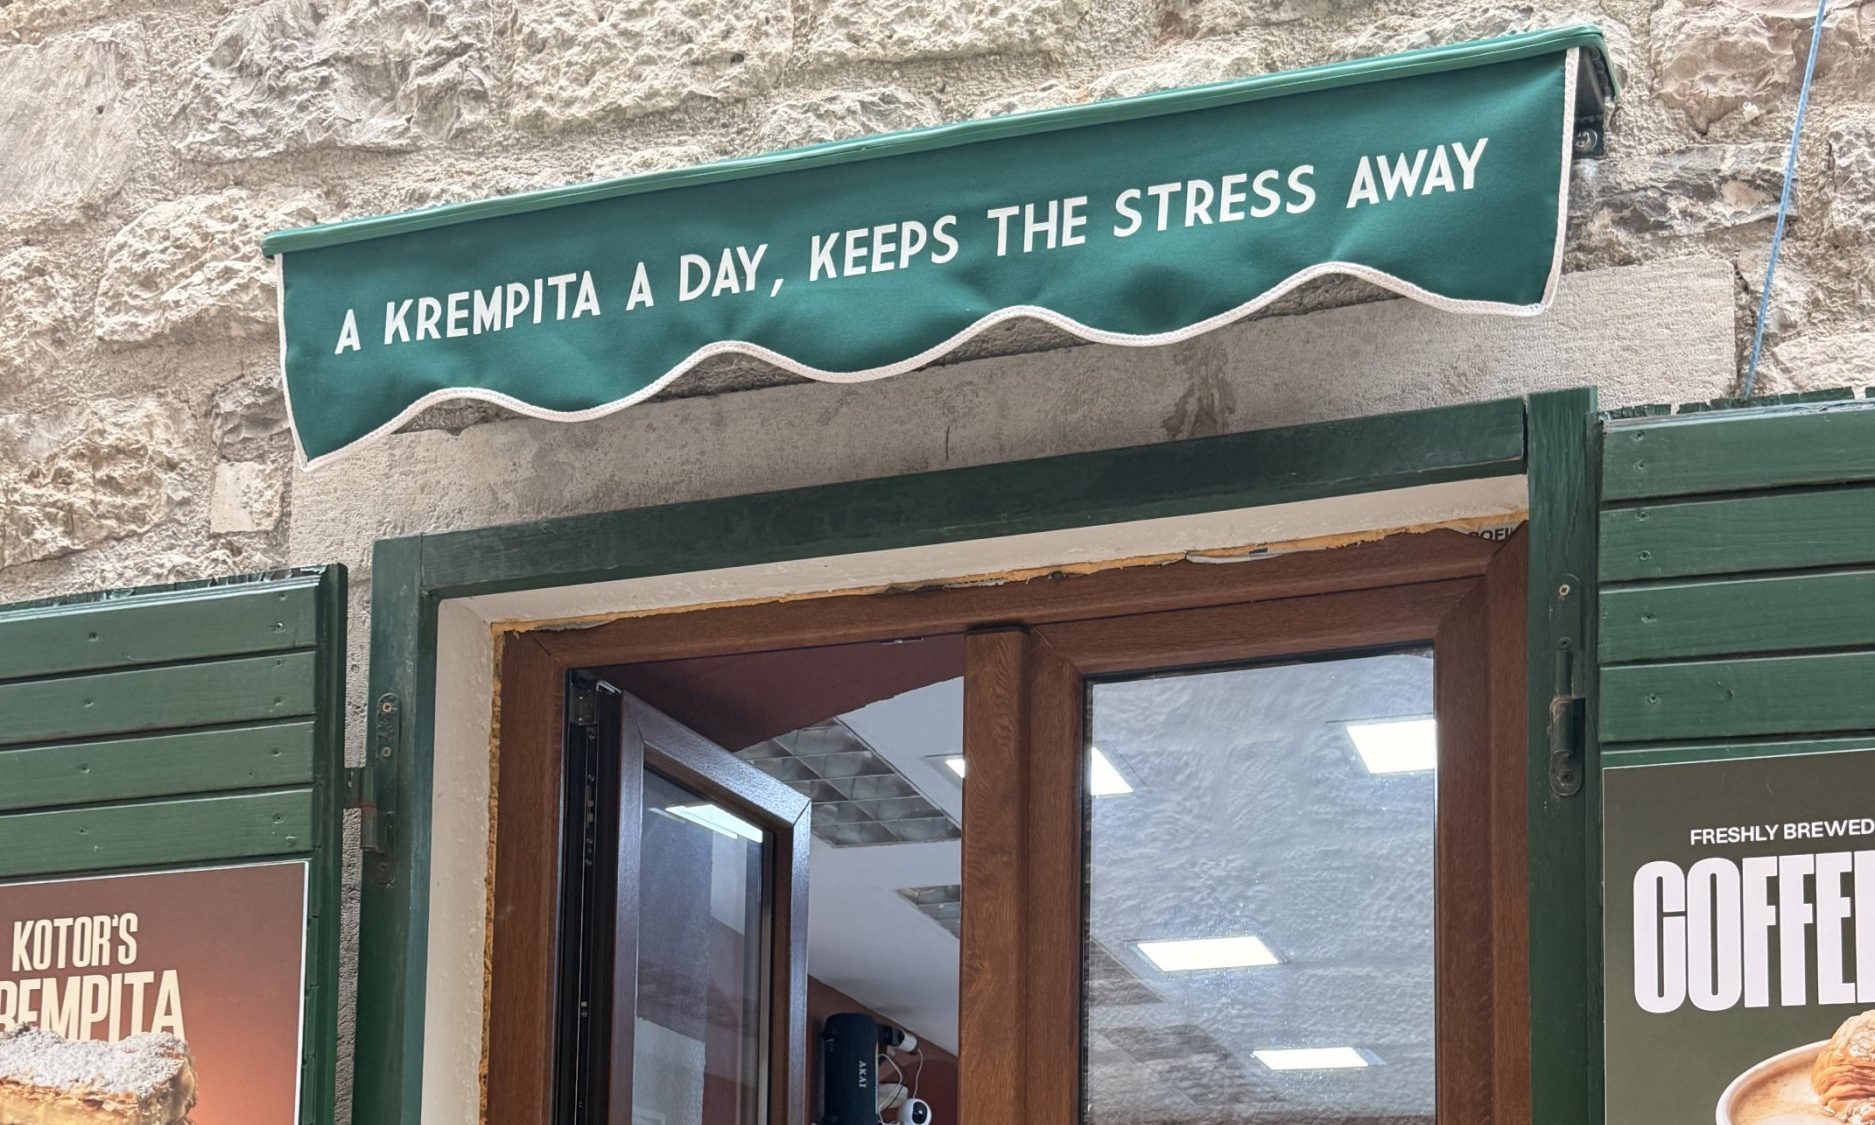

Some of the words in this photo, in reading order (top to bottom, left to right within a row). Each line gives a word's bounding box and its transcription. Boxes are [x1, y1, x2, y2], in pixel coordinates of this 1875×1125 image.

[335, 310, 360, 354] A
[384, 270, 600, 344] KREMPITA
[626, 262, 654, 310] A
[679, 244, 784, 300] DAY,
[809, 213, 957, 281] KEEPS
[988, 197, 1087, 256] THE
[1114, 165, 1315, 237] STRESS
[1346, 139, 1488, 209] AWAY
[1690, 824, 1778, 845] FRESHLY
[1783, 818, 1875, 839] BREWED
[12, 912, 138, 971] KOTOR'S
[859, 1060, 867, 1087] AKAI
